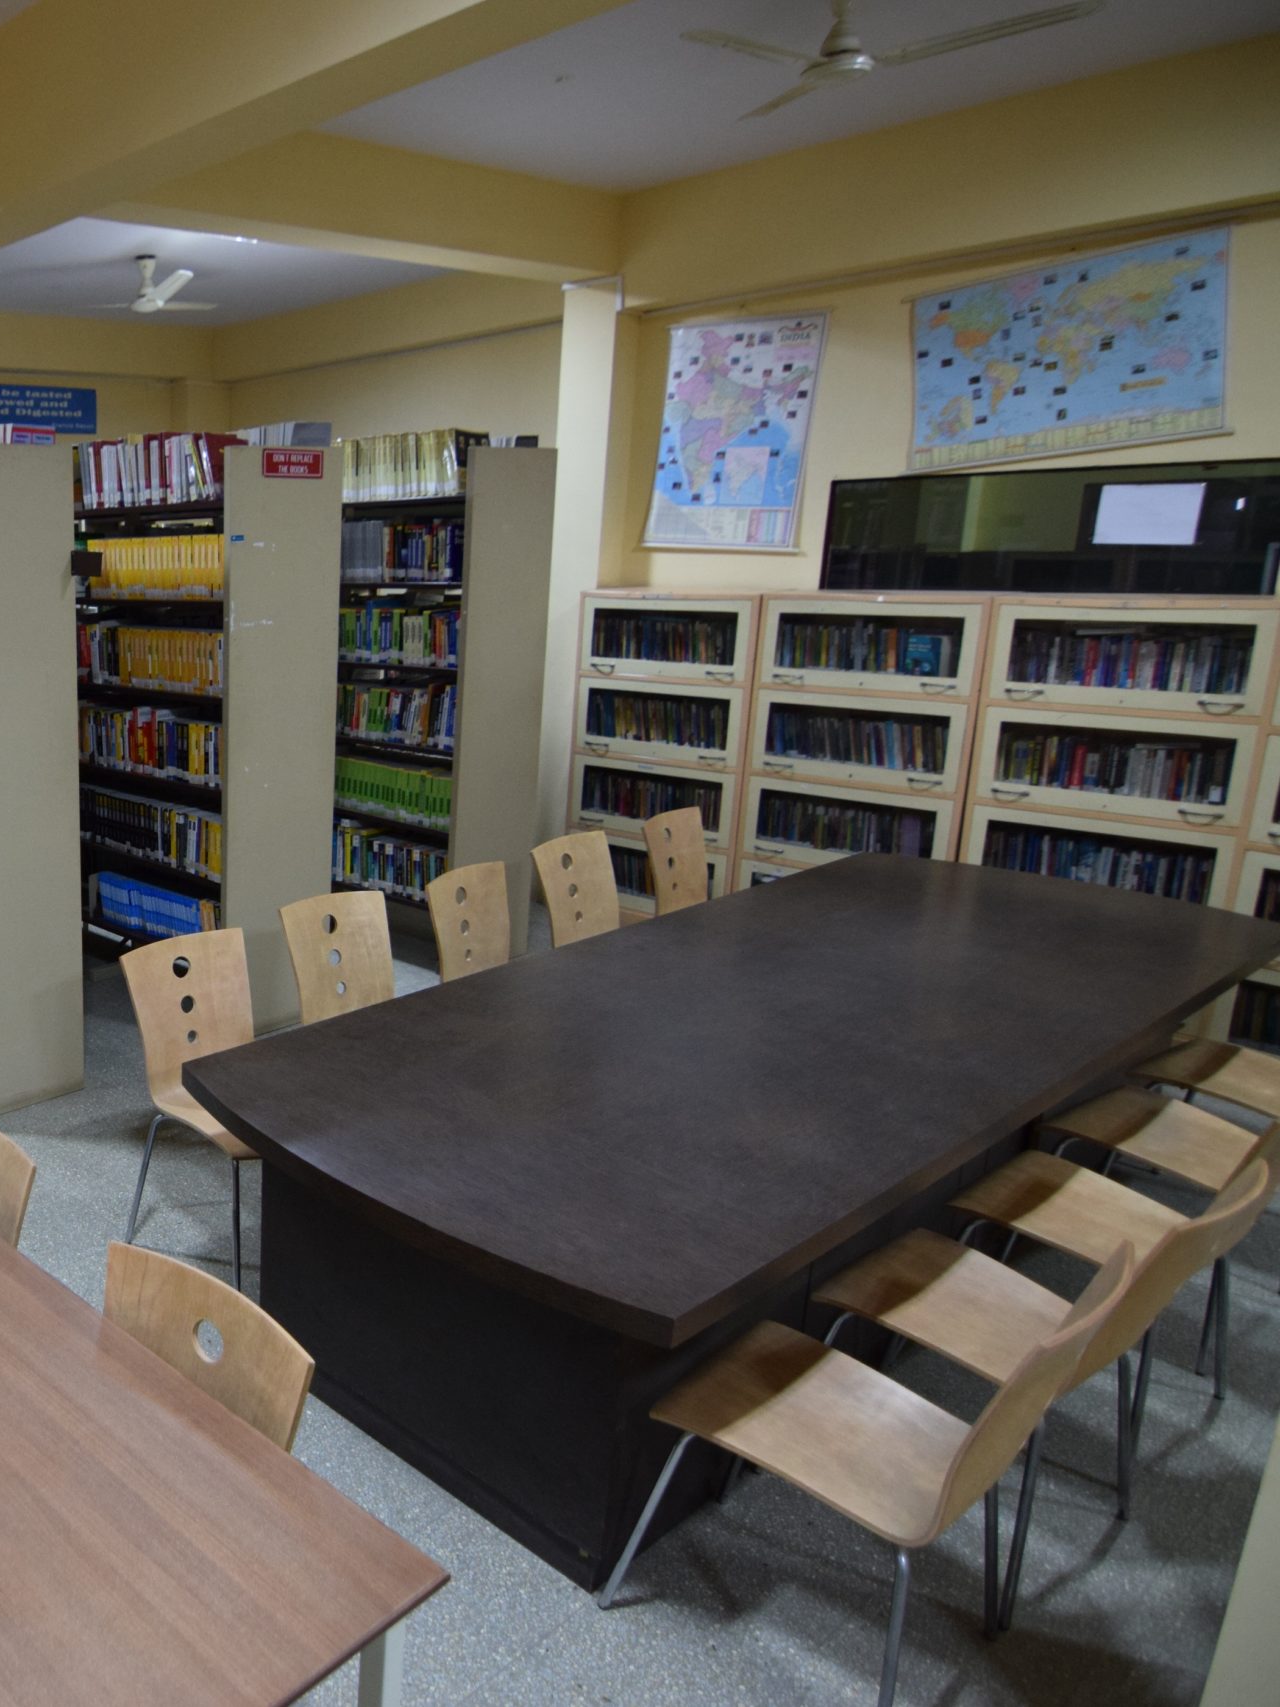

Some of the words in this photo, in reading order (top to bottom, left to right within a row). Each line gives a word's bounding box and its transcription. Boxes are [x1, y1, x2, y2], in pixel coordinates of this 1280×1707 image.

[1, 387, 21, 398] be
[25, 389, 72, 399] tasted
[40, 397, 68, 408] and
[15, 406, 83, 418] Digested
